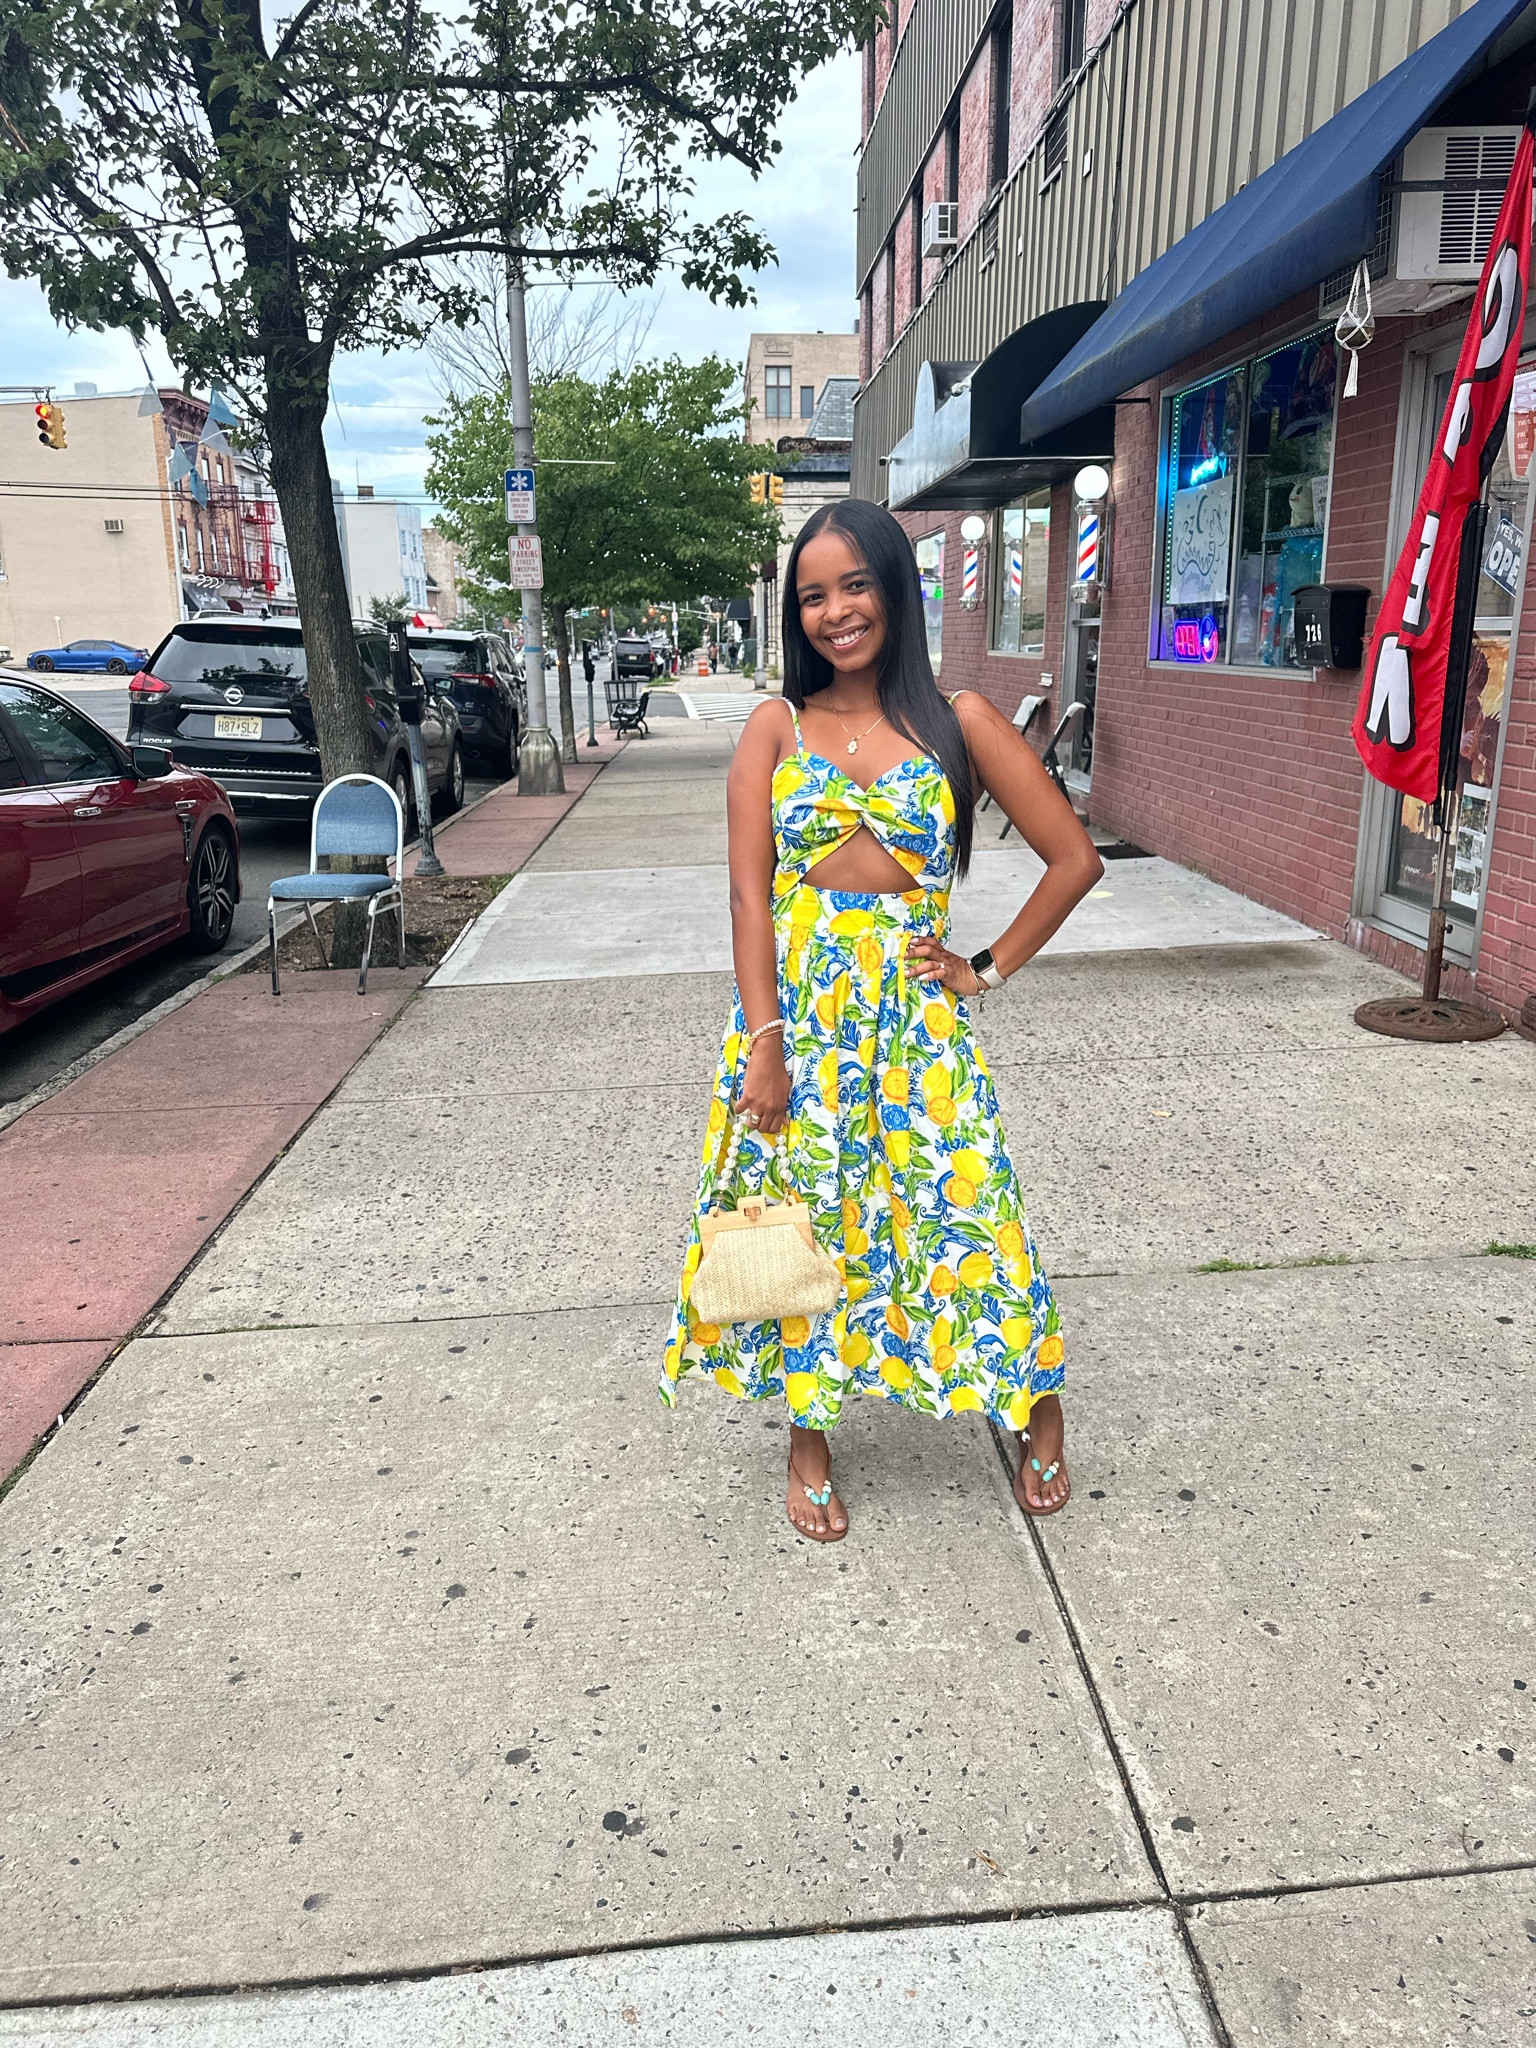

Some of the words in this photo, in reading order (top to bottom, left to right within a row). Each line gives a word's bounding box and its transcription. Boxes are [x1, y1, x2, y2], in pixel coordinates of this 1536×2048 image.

[1500, 522, 1514, 544] YES,
[518, 539, 531, 550] NO
[512, 550, 539, 559] PARKING
[1489, 541, 1520, 590] OPE
[390, 634, 397, 645] A
[1305, 623, 1322, 642] 726
